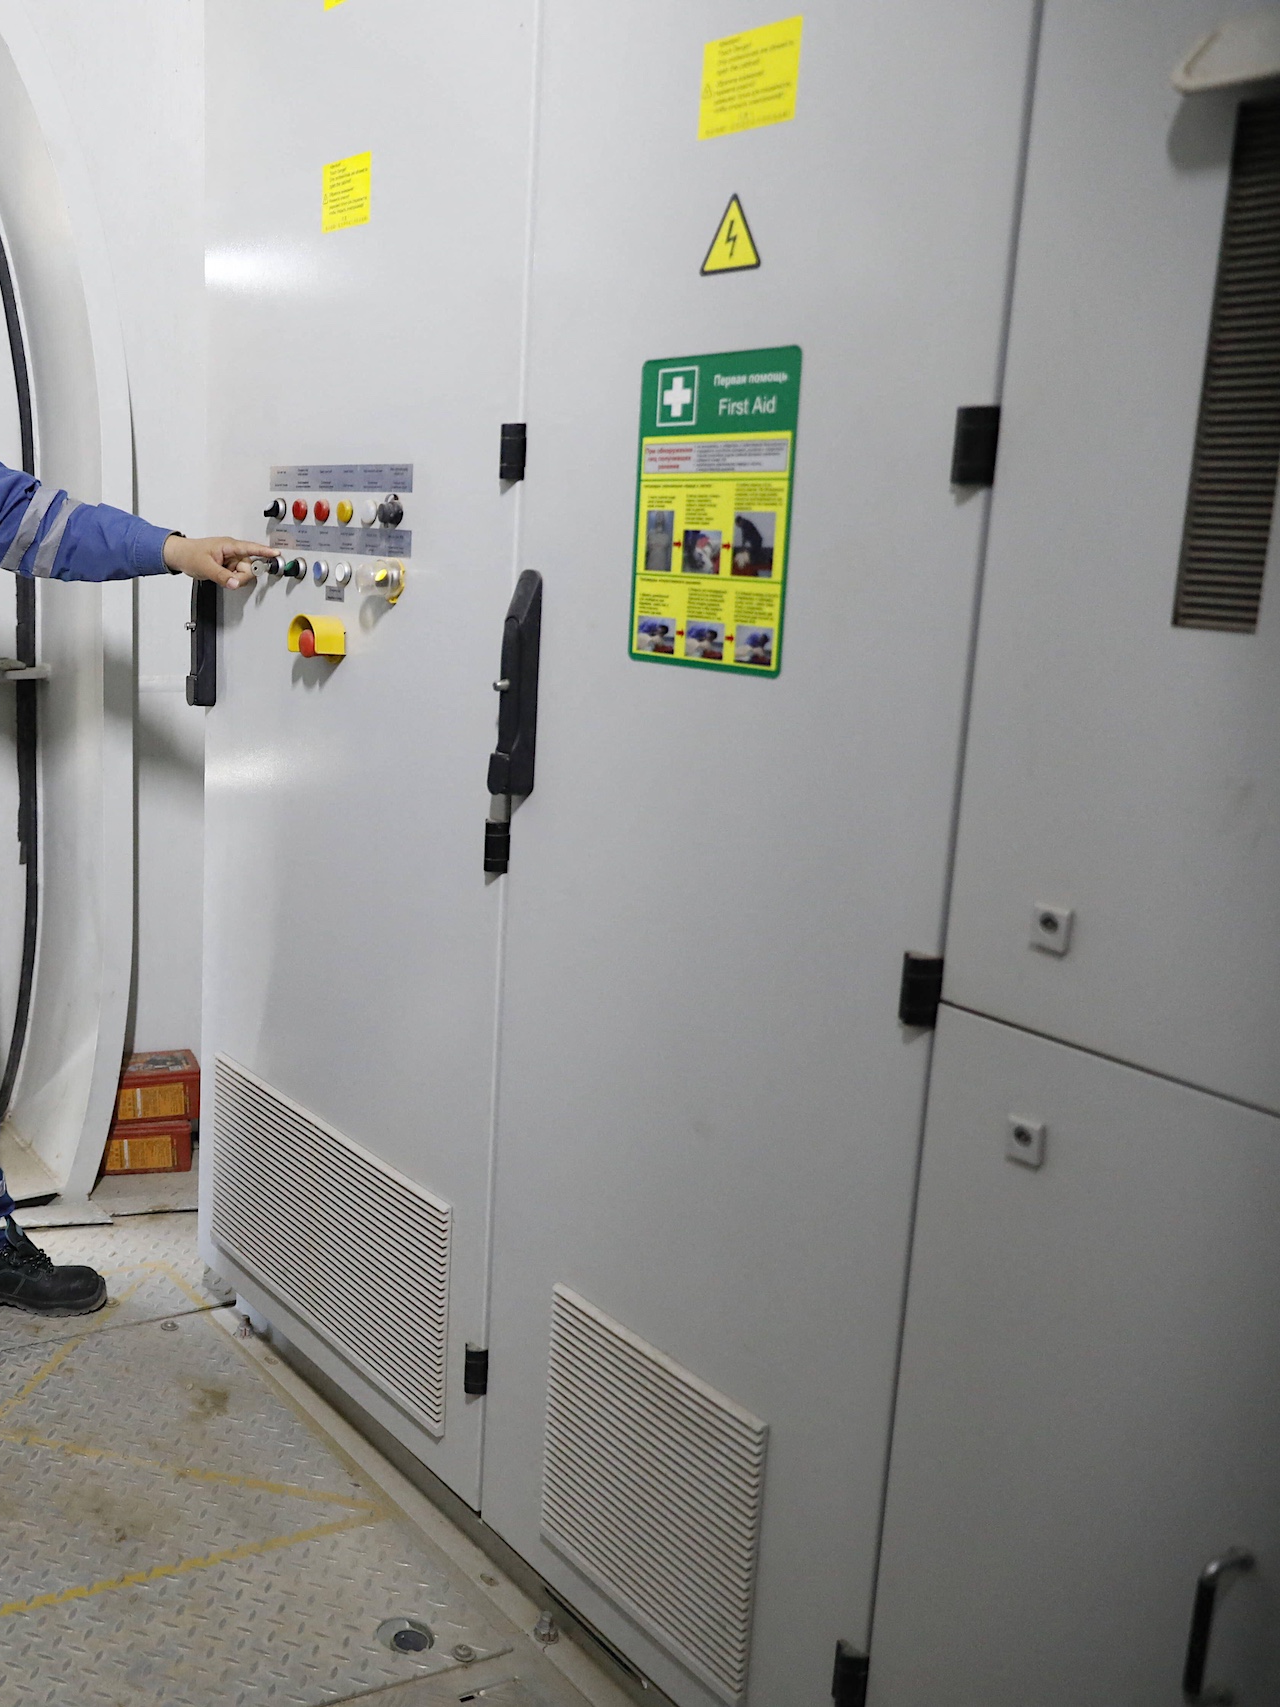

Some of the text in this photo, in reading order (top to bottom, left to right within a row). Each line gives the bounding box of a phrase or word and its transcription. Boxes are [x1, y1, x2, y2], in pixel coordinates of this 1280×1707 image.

[714, 372, 788, 388] Первая помощь
[718, 395, 777, 416] First Aid
